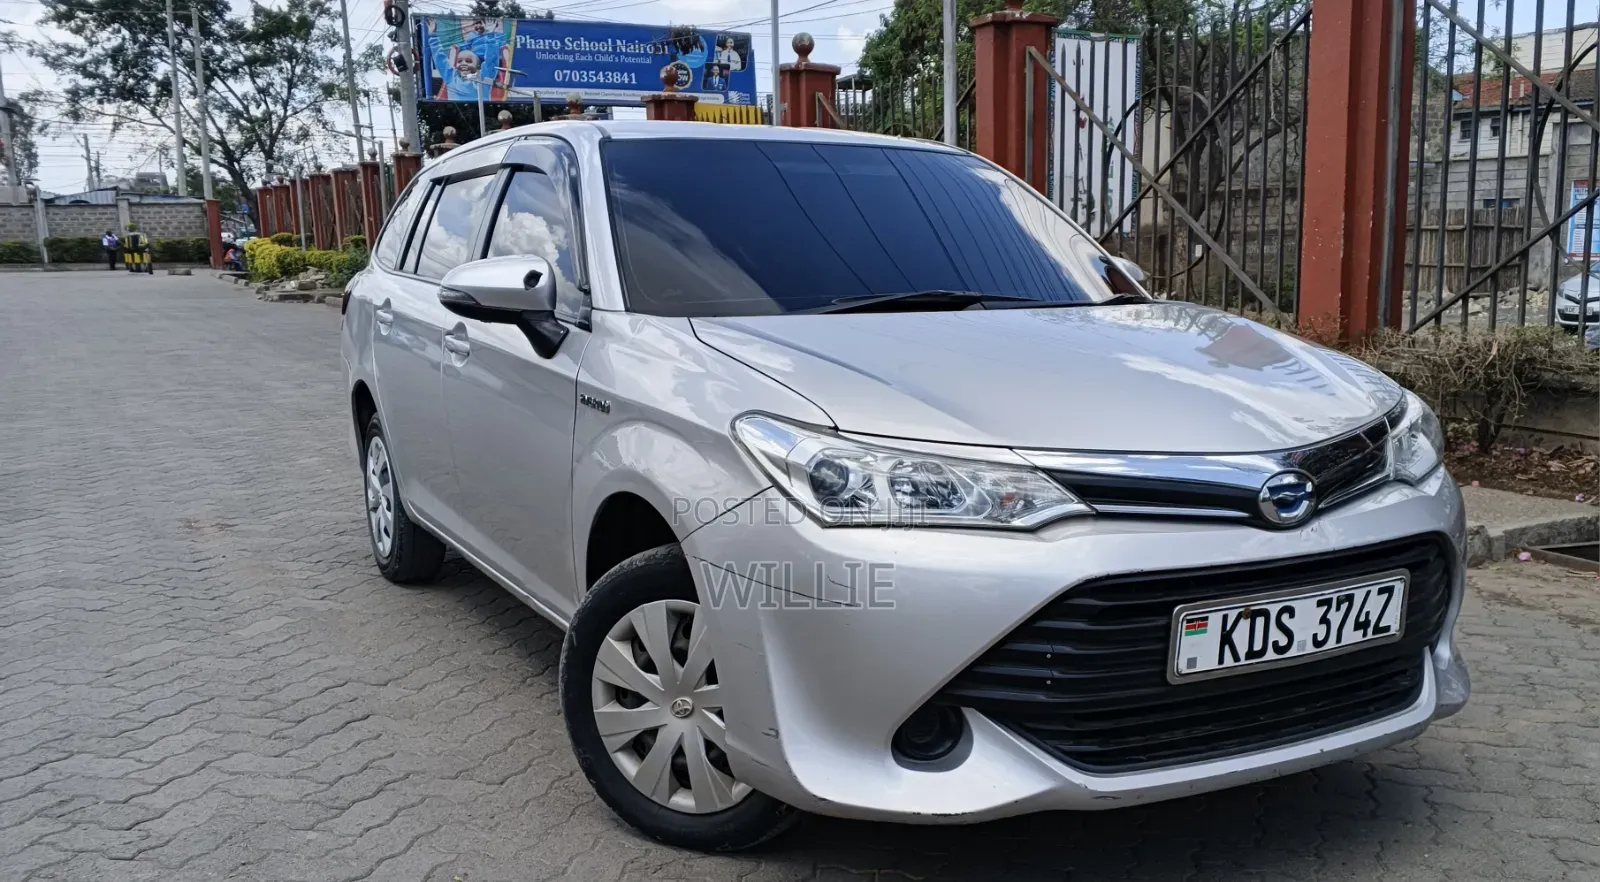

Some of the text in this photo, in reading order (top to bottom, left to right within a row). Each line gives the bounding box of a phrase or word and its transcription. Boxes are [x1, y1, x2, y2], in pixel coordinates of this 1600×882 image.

[515, 34, 561, 50] Pharo
[564, 36, 613, 52] School
[535, 51, 652, 64] Unlocking Each Child's Potential
[554, 69, 638, 84] 0703543841
[1218, 604, 1296, 666] KDS
[1312, 584, 1396, 650] 374Z
